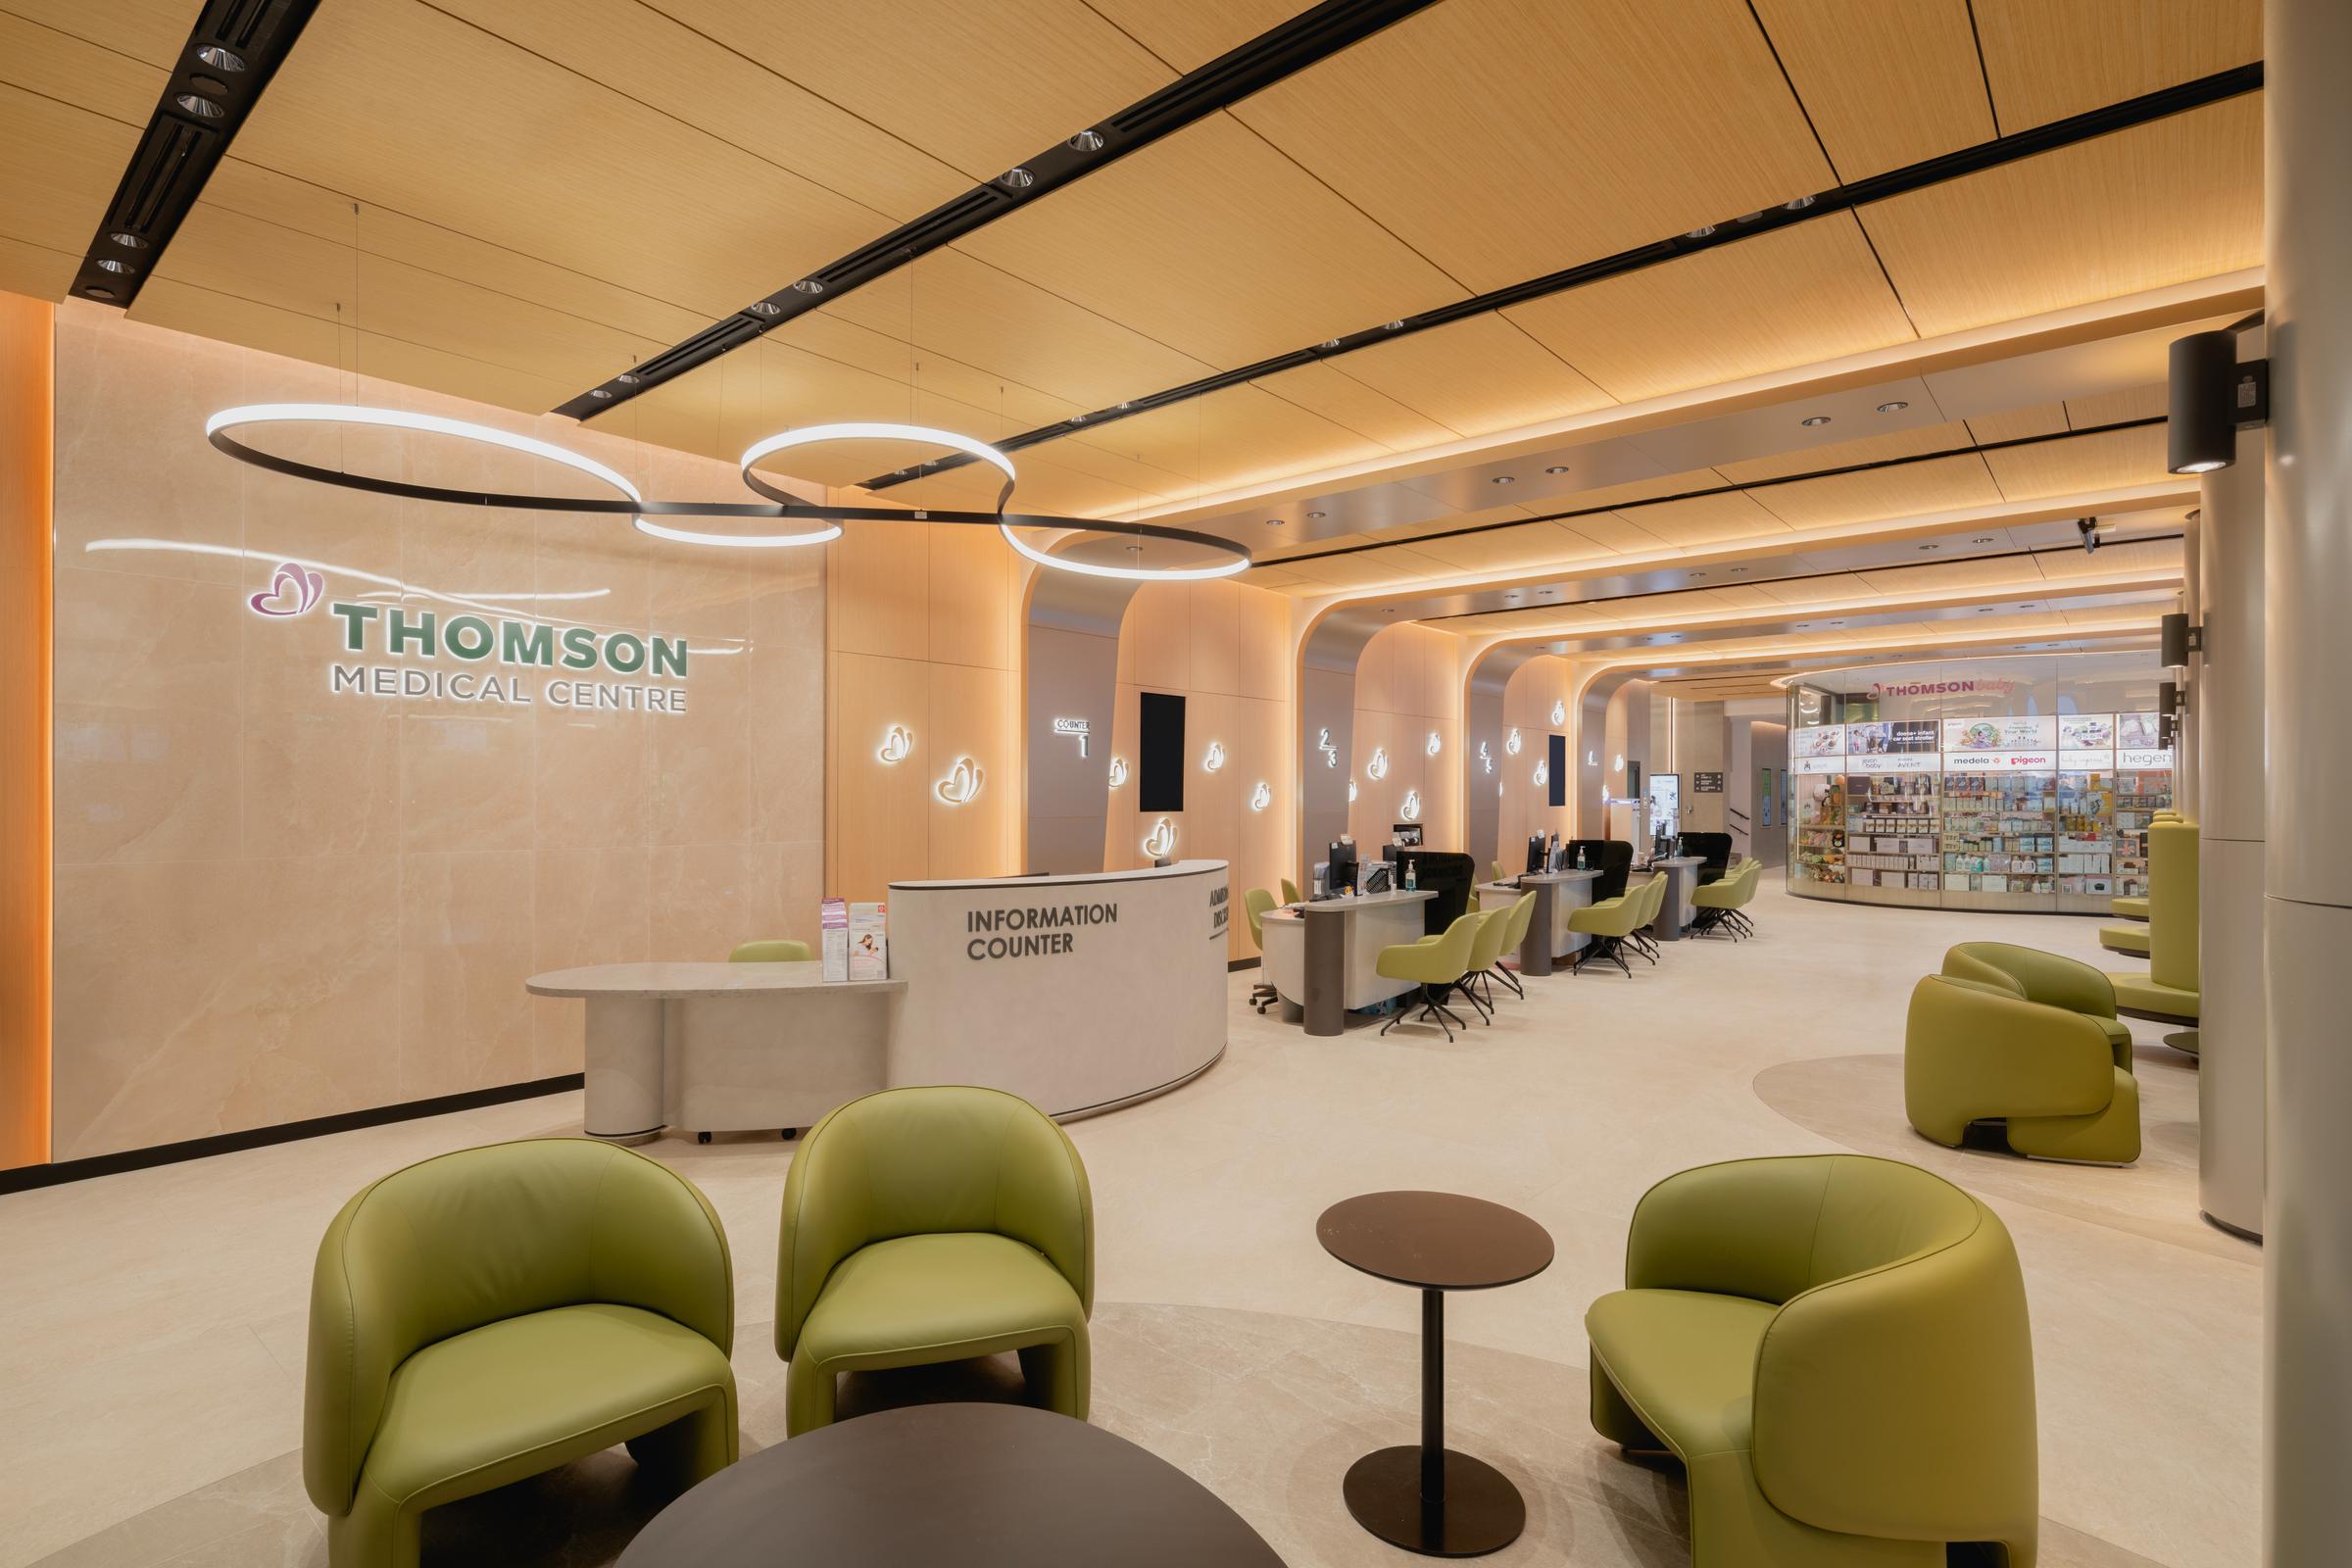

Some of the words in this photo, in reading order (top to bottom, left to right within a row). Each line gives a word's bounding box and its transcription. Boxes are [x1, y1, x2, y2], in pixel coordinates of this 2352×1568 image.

[332, 603, 688, 677] THOMSON
[332, 664, 533, 705] MEDICAL
[547, 679, 689, 712] CENTRE
[1886, 680, 1975, 697] THOMSON
[1057, 719, 1090, 729] COUNTER
[1320, 728, 1331, 746] 2
[1328, 750, 1338, 767] 3
[2011, 756, 2046, 765] pigeon
[967, 903, 1119, 934] INFORMATION
[966, 932, 1074, 961] COUNTER
